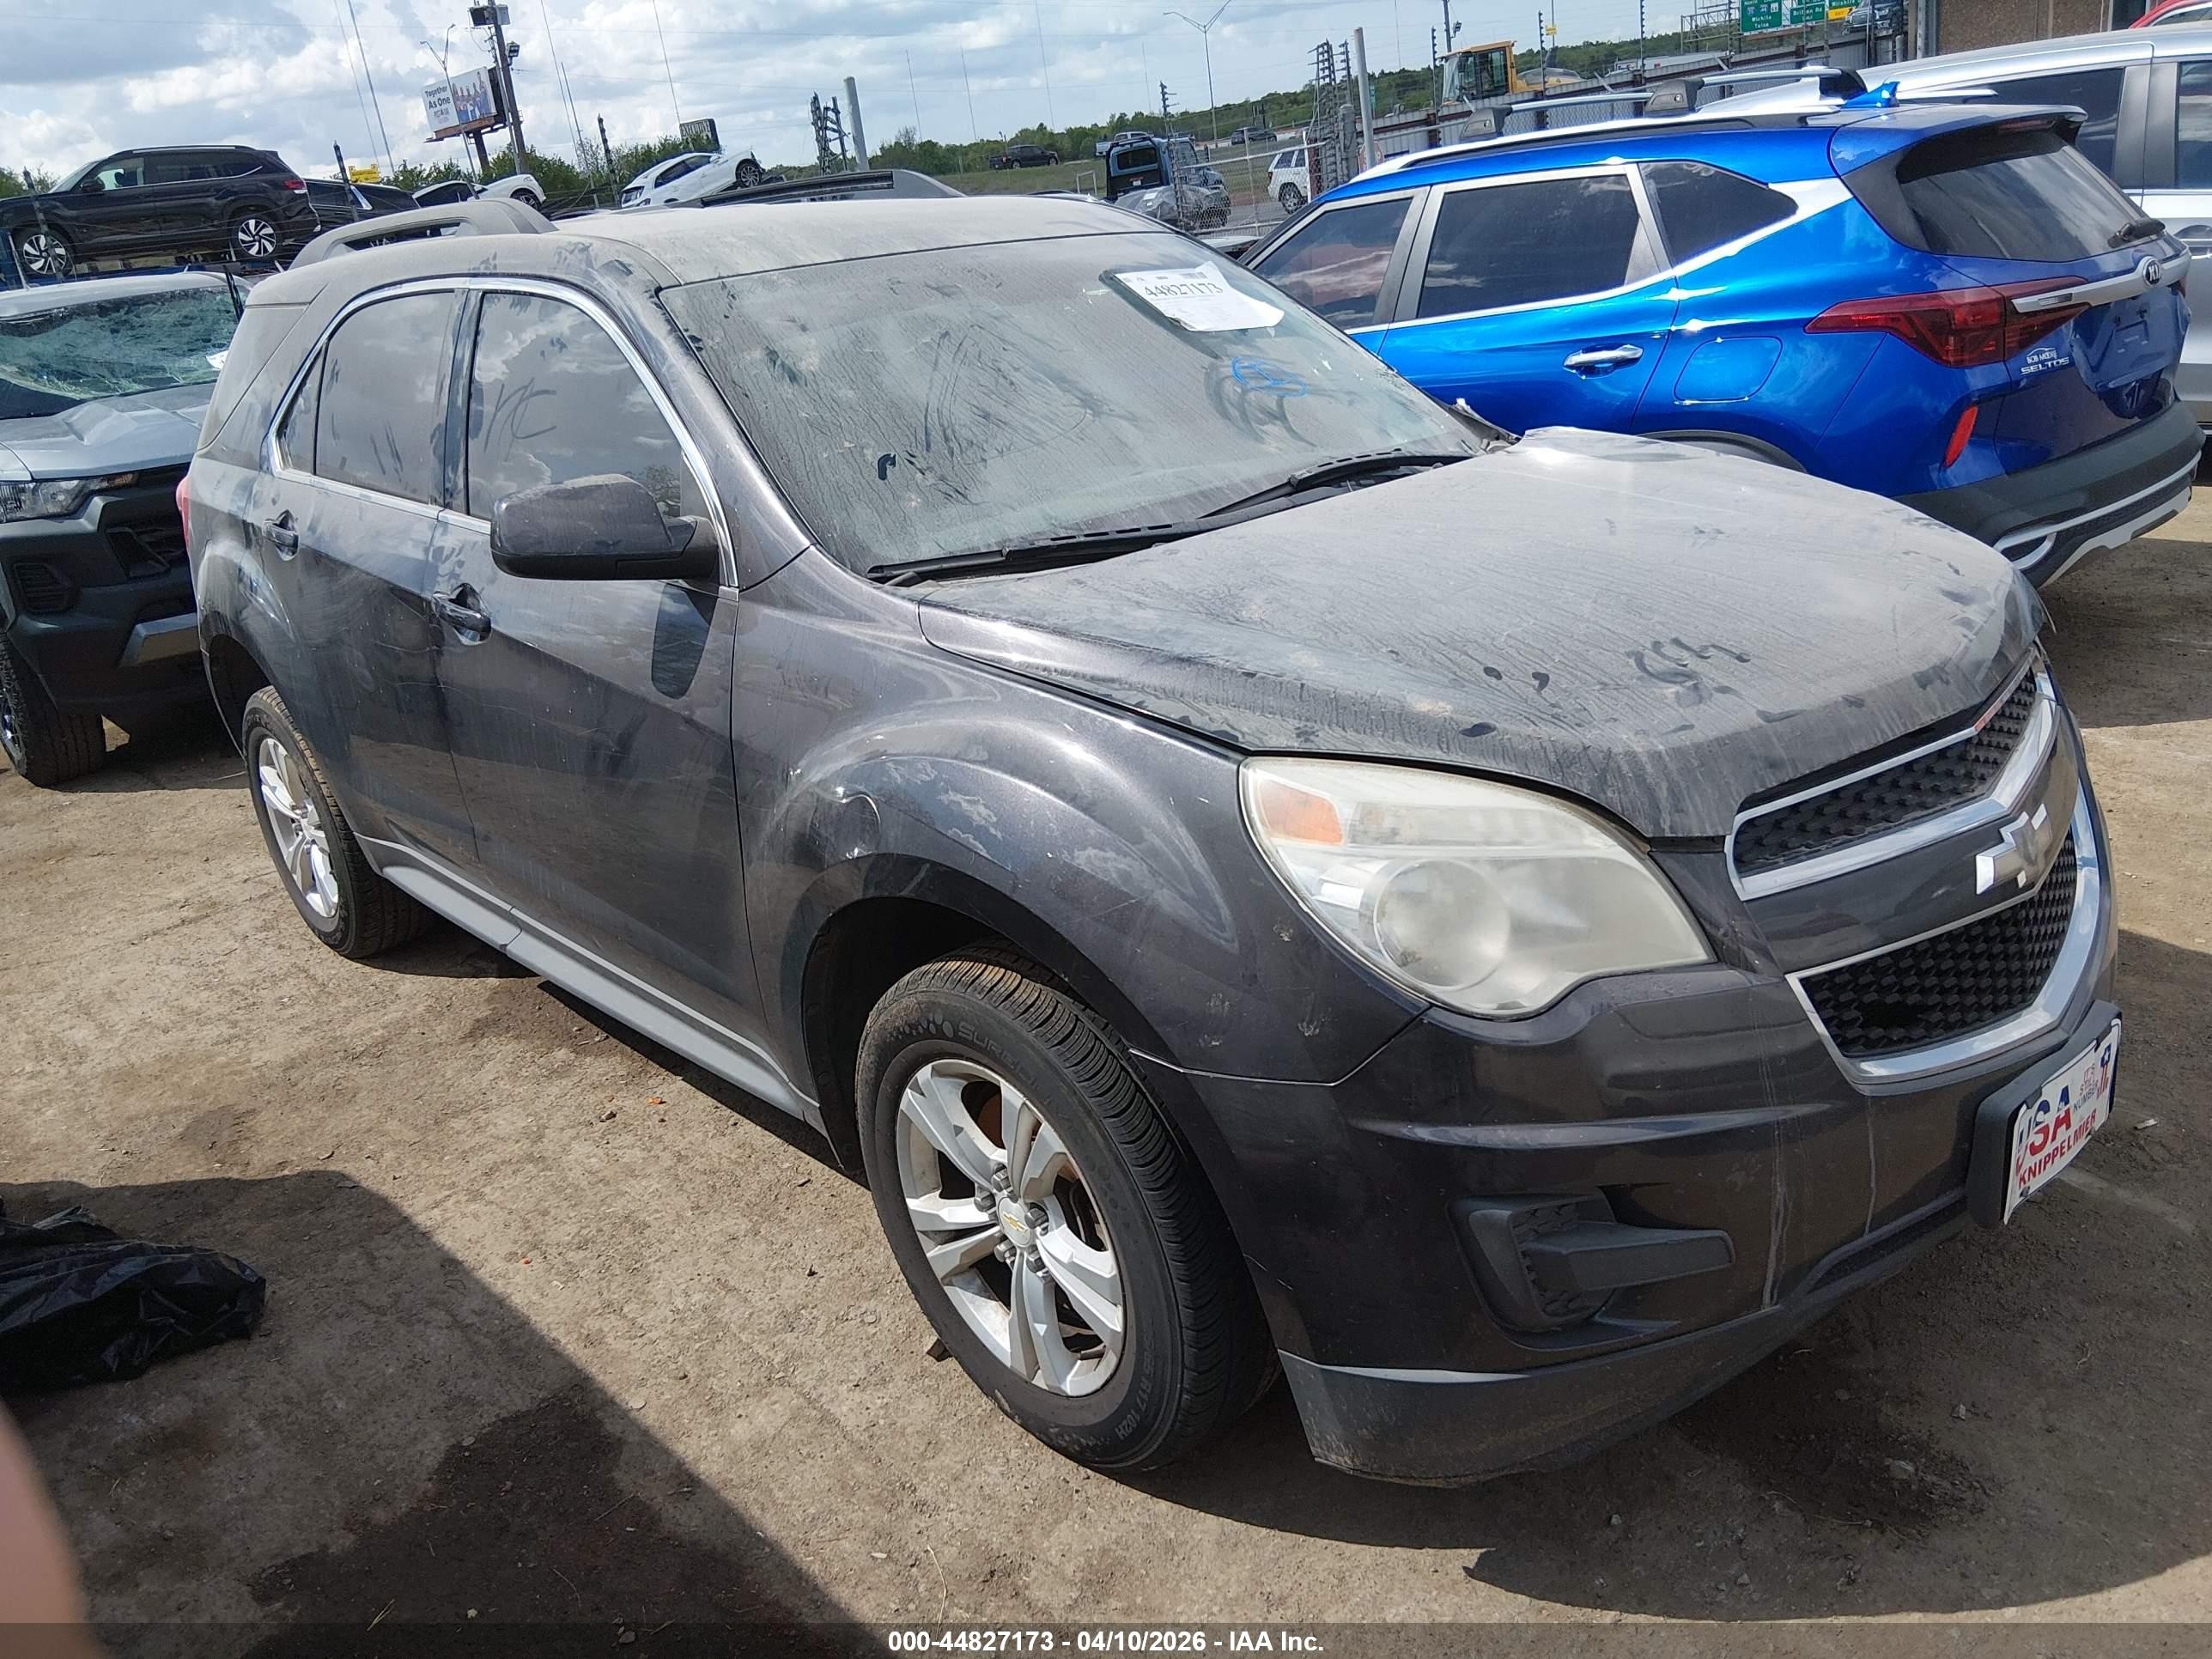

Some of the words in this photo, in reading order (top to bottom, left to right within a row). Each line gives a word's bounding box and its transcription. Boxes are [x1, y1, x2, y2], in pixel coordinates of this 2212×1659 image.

[425, 86, 447, 98] Together
[428, 100, 438, 110] As
[437, 96, 451, 106] One
[1144, 283, 1224, 298] 44827173
[2021, 357, 2069, 375] SELTOS
[2018, 1108, 2097, 1188] KNIPPELMIER
